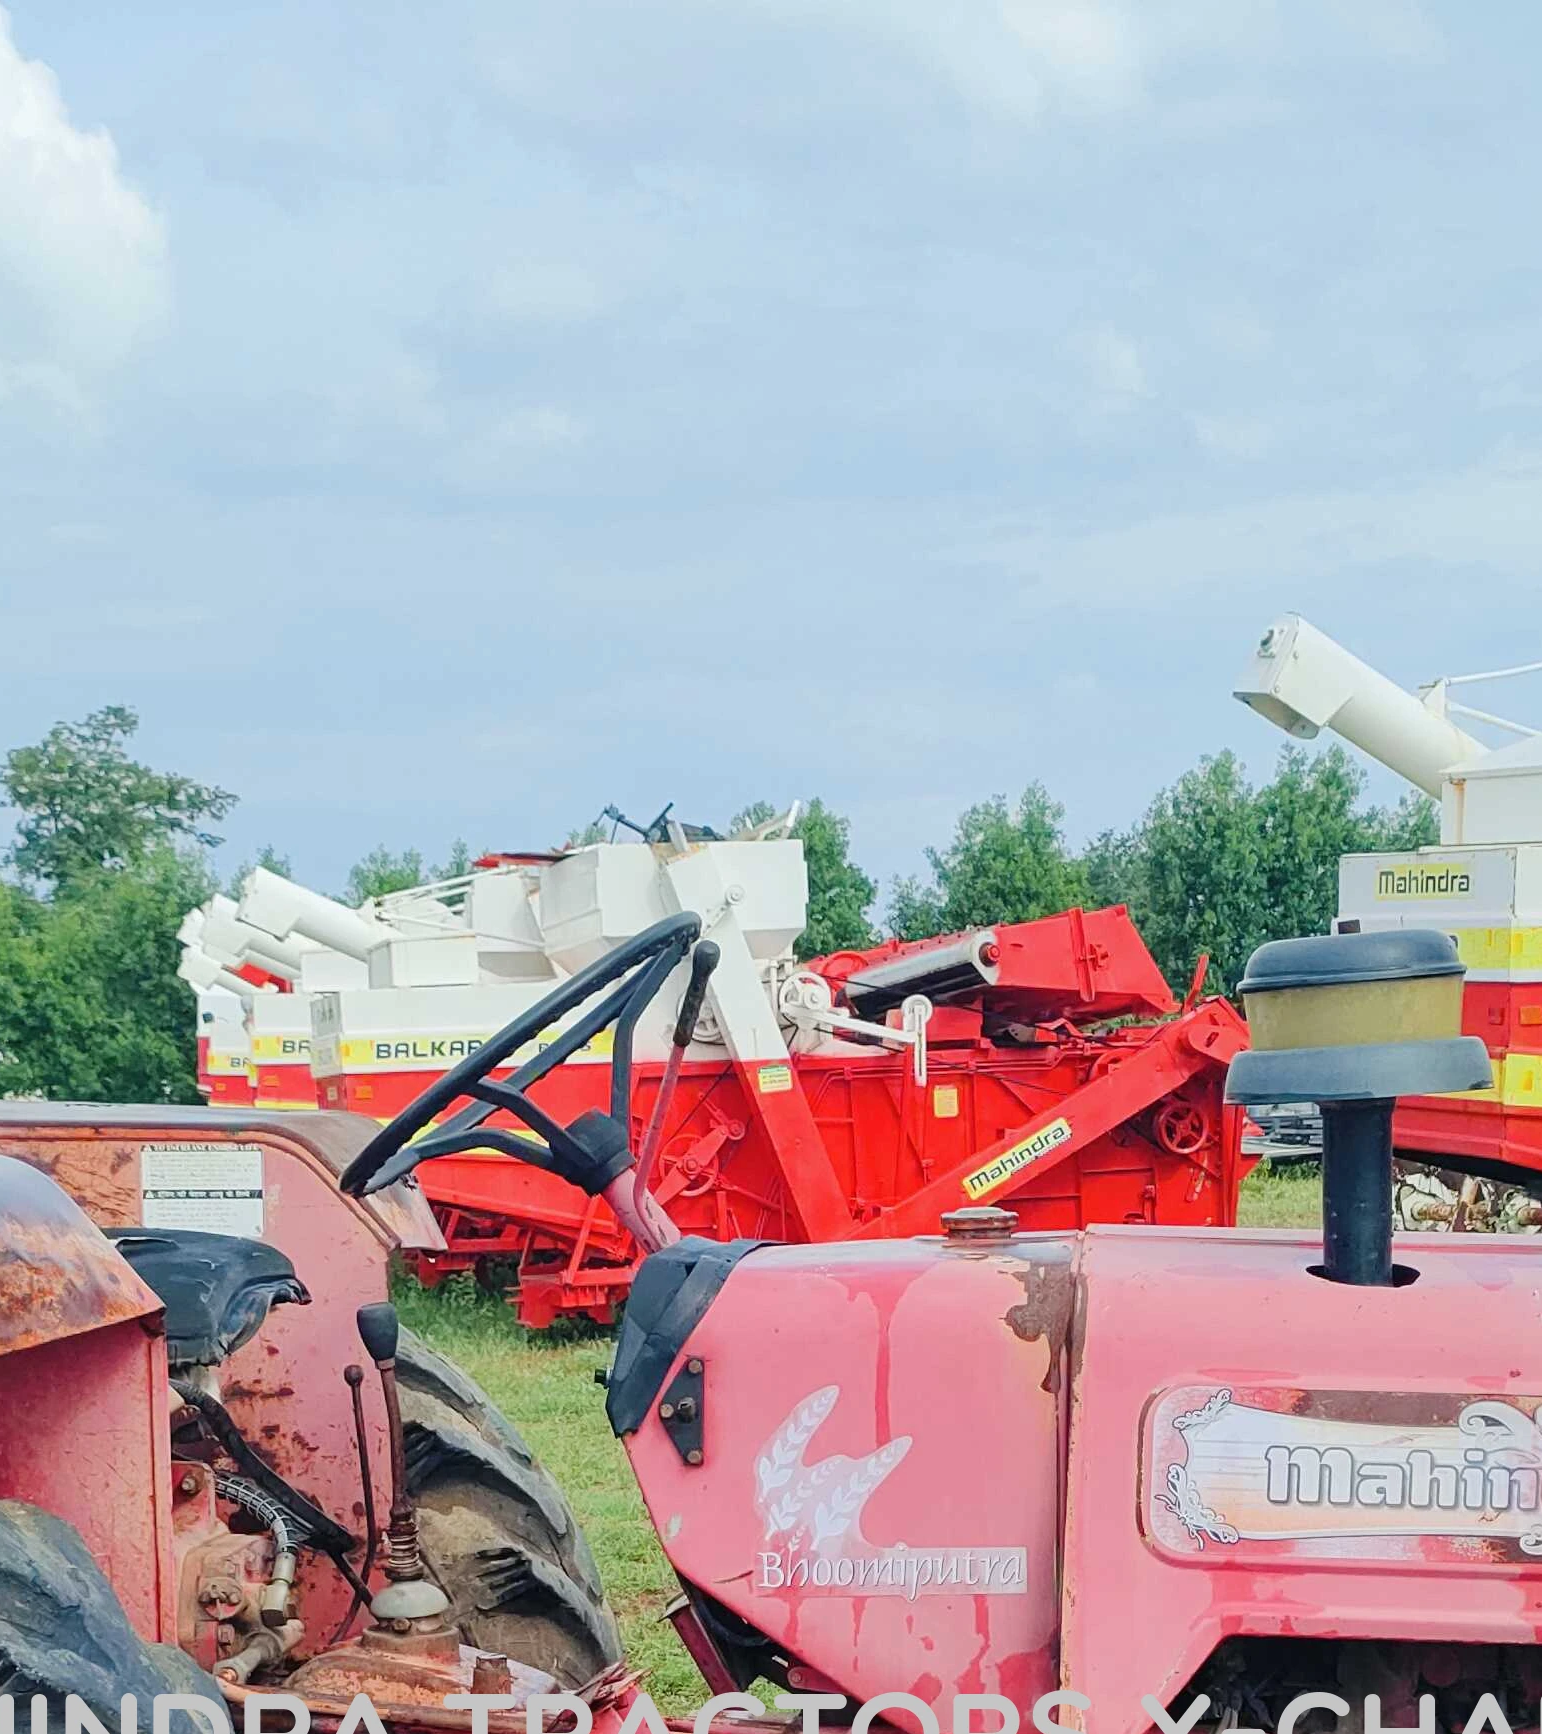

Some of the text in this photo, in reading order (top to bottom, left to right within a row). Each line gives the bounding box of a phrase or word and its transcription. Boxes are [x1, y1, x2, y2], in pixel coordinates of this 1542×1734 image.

[1378, 859, 1471, 895] Mahindra
[969, 1124, 1066, 1193] Mahindra
[756, 1535, 1026, 1602] Bhoomiputra
